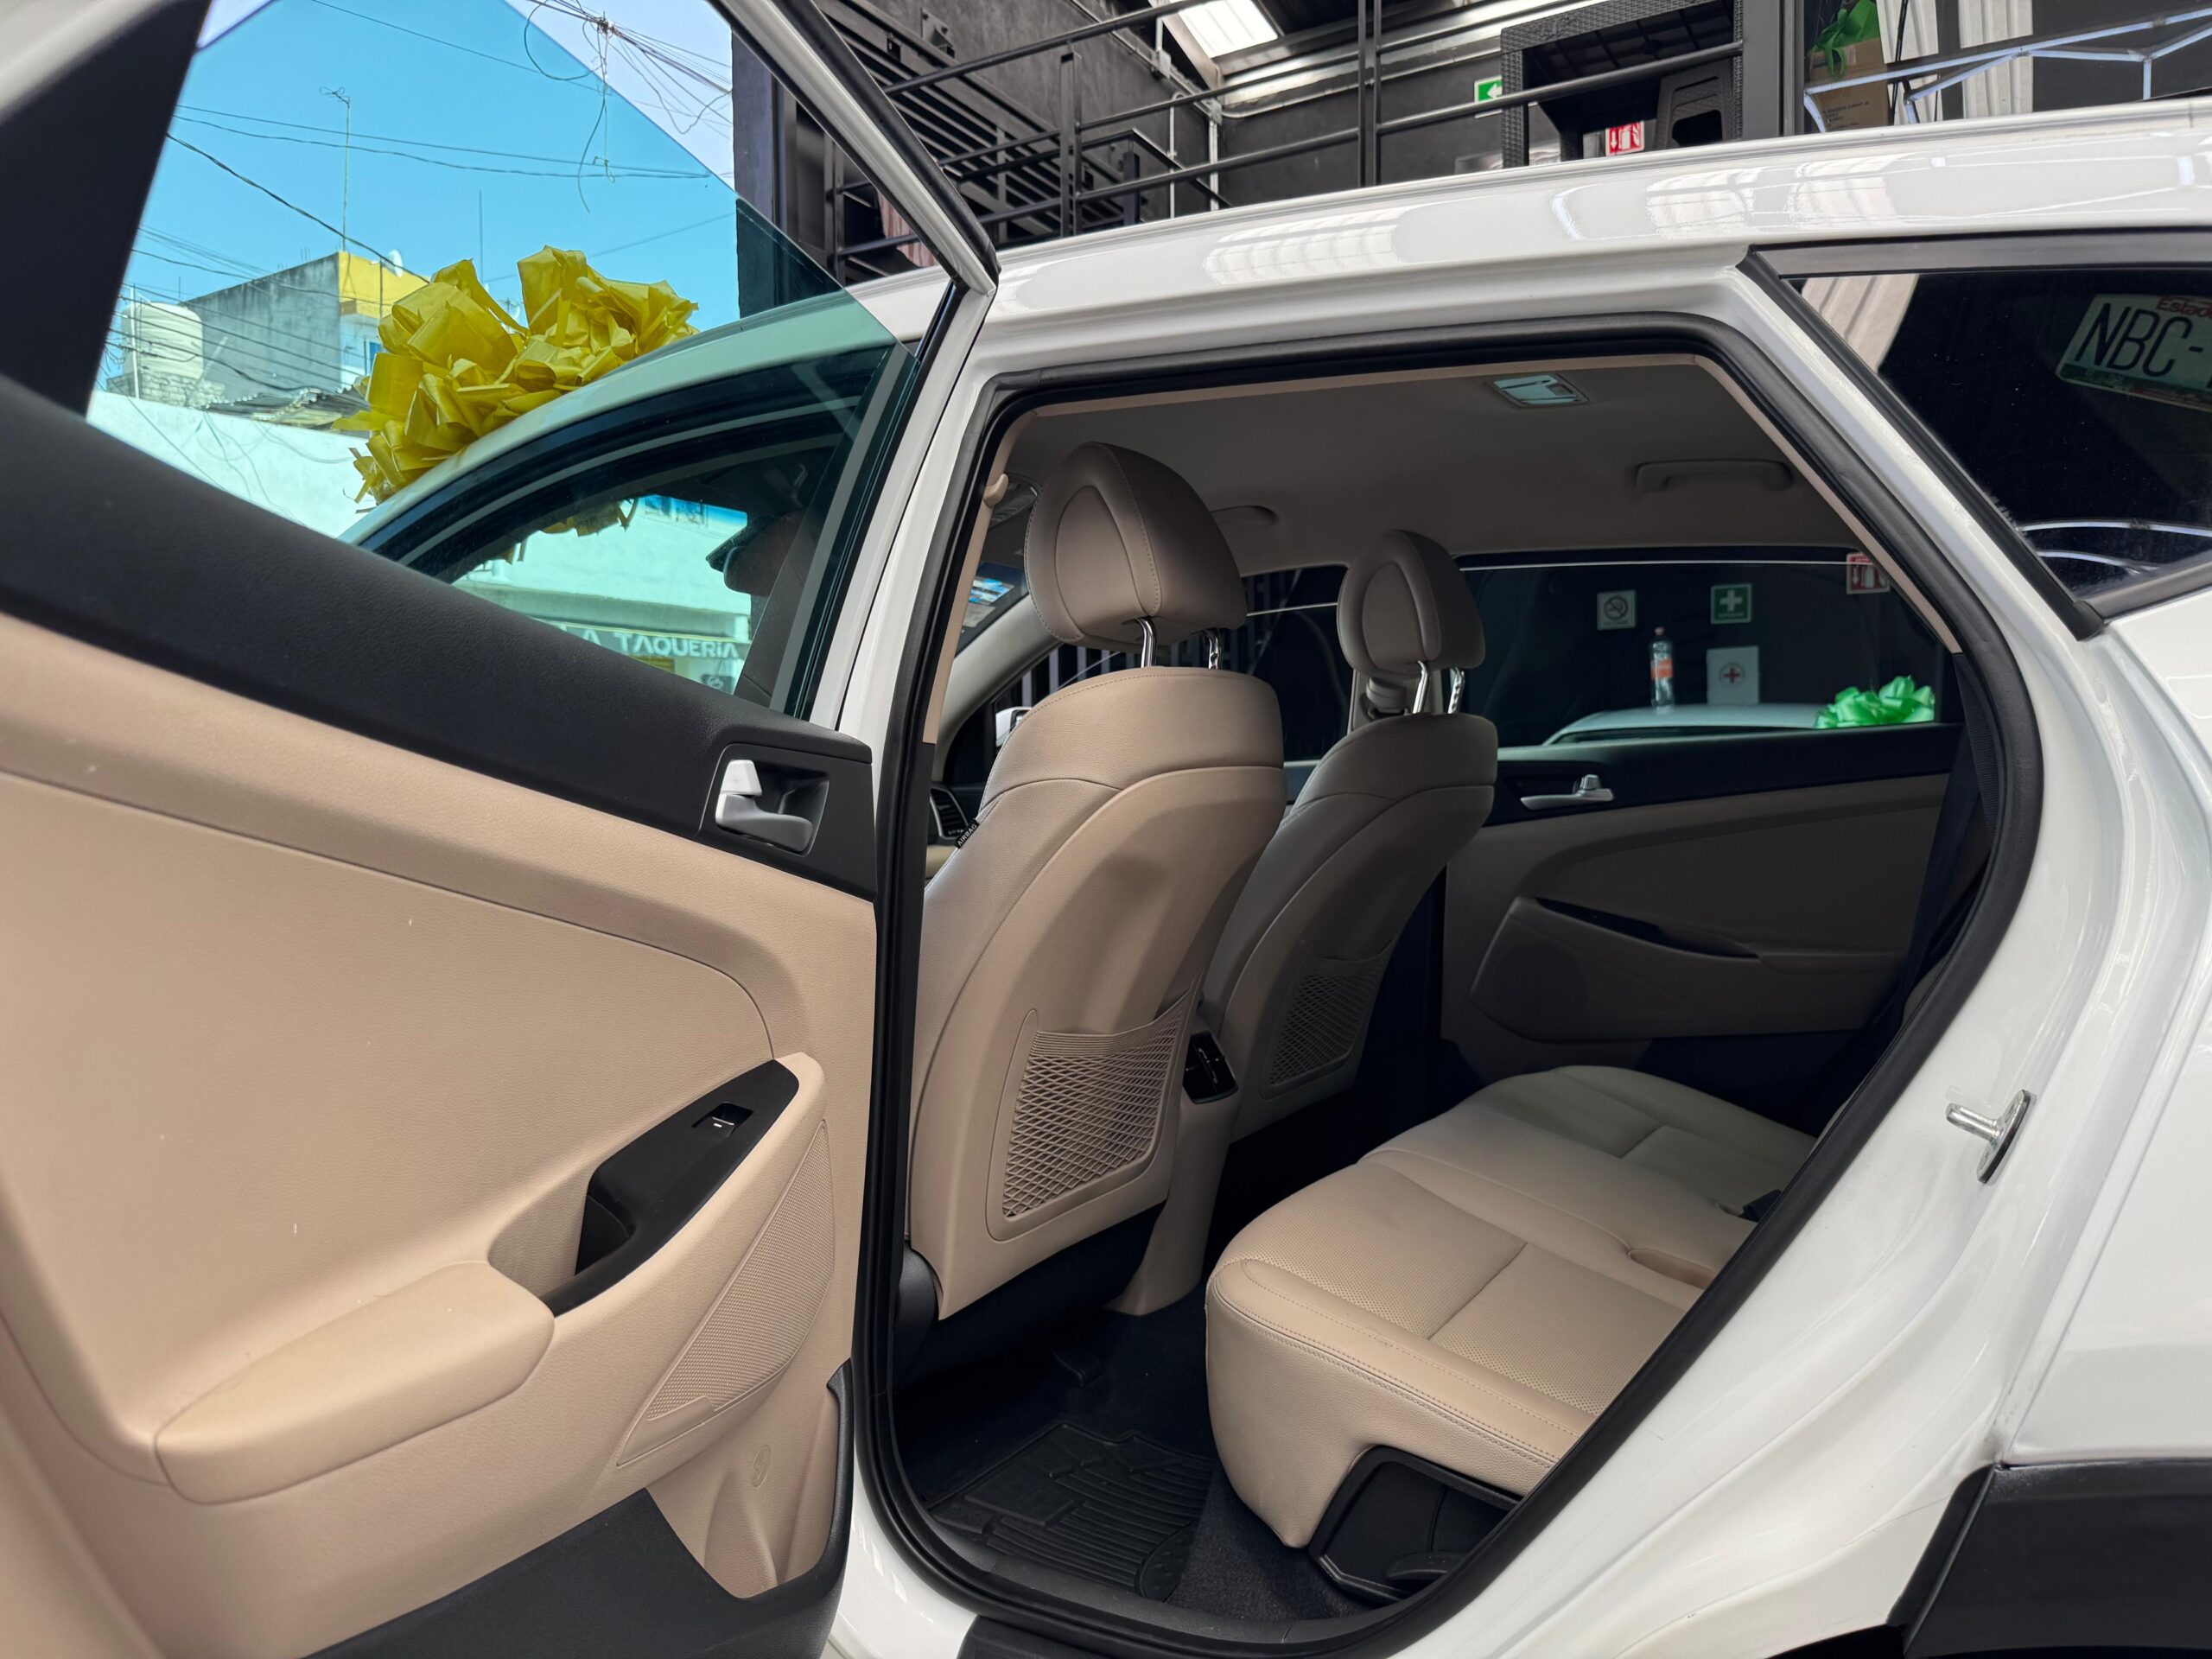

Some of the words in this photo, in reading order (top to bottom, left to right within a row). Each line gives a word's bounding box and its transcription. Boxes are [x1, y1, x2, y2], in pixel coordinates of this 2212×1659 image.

[2156, 295, 2212, 318] Estad
[2074, 302, 2212, 389] NBC-
[957, 823, 977, 846] AIRBAG
